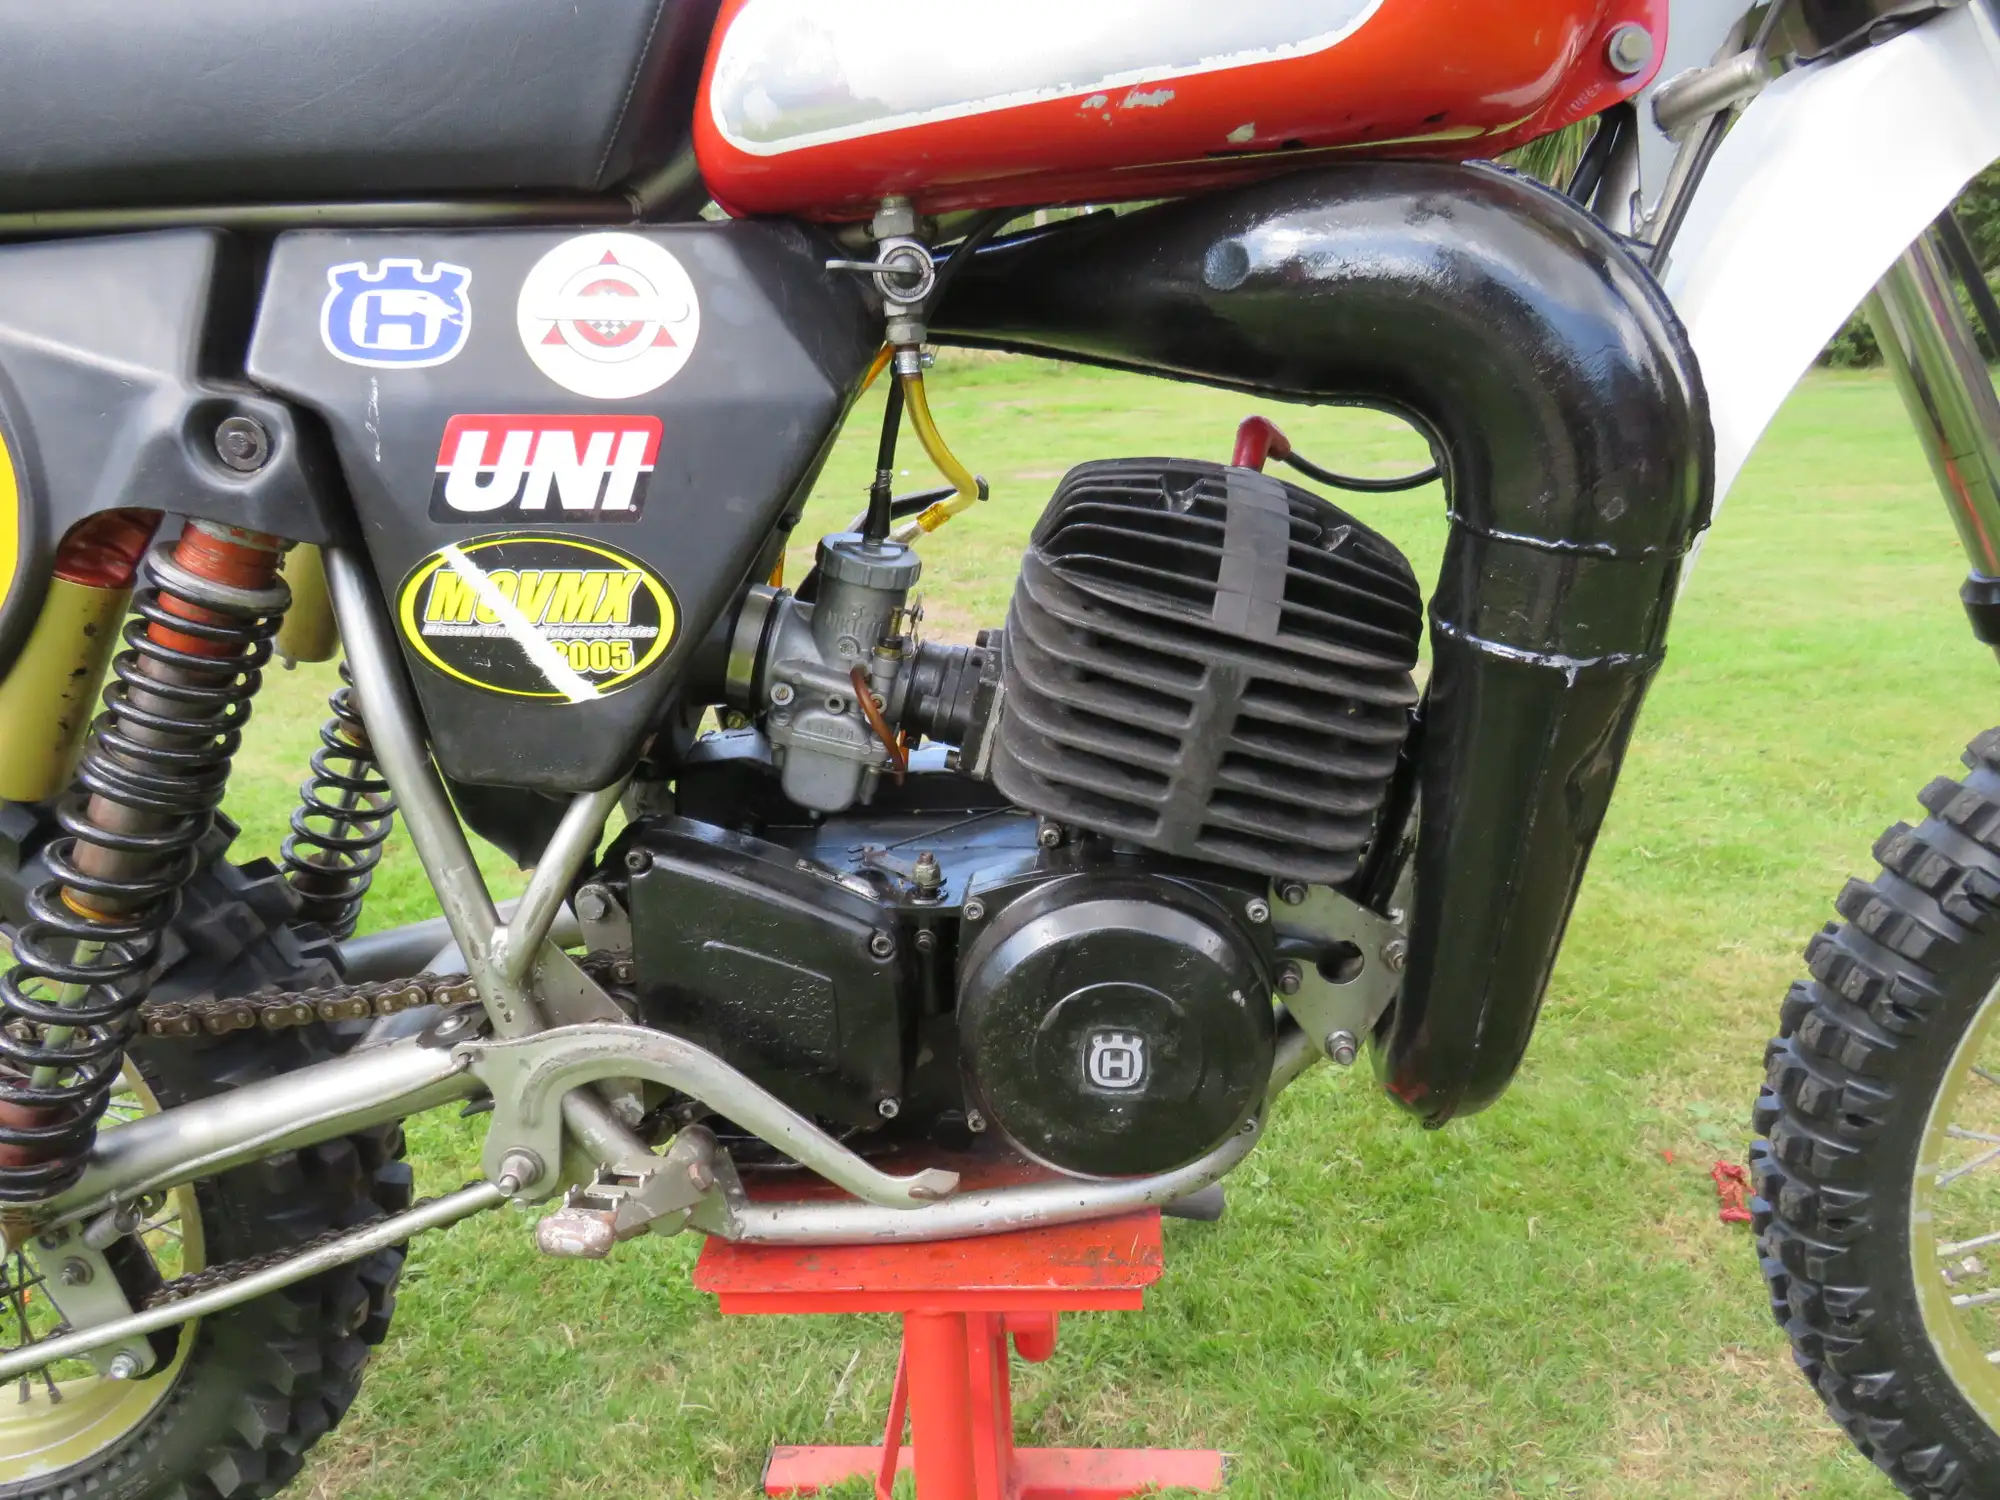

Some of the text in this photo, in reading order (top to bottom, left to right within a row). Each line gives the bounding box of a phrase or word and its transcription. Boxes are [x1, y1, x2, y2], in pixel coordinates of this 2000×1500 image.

[444, 430, 650, 512] UNI
[424, 569, 643, 625] MOVMX
[422, 624, 481, 637] Missouri
[611, 625, 659, 639] Series
